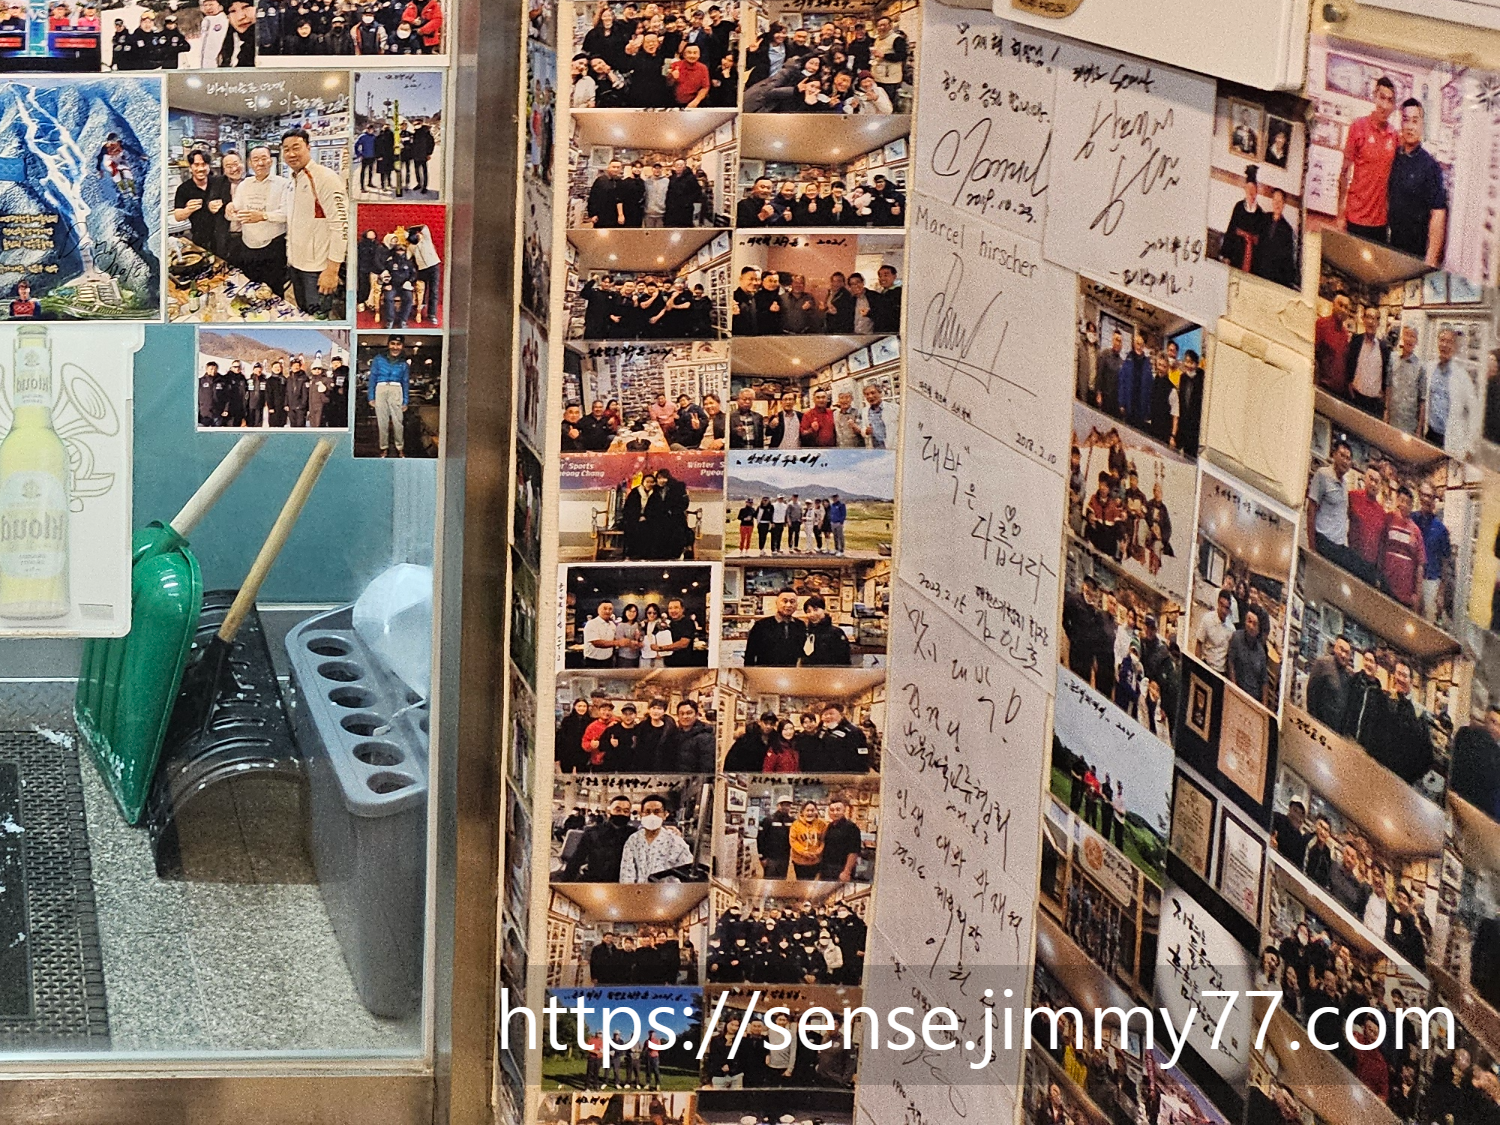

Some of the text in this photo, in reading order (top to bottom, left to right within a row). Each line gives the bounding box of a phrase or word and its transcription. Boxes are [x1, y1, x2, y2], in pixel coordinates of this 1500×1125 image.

[915, 205, 1039, 280] Marcel hirscher
[569, 461, 595, 471] Sports
[687, 461, 715, 469] Winter
[581, 469, 606, 478] Chang
